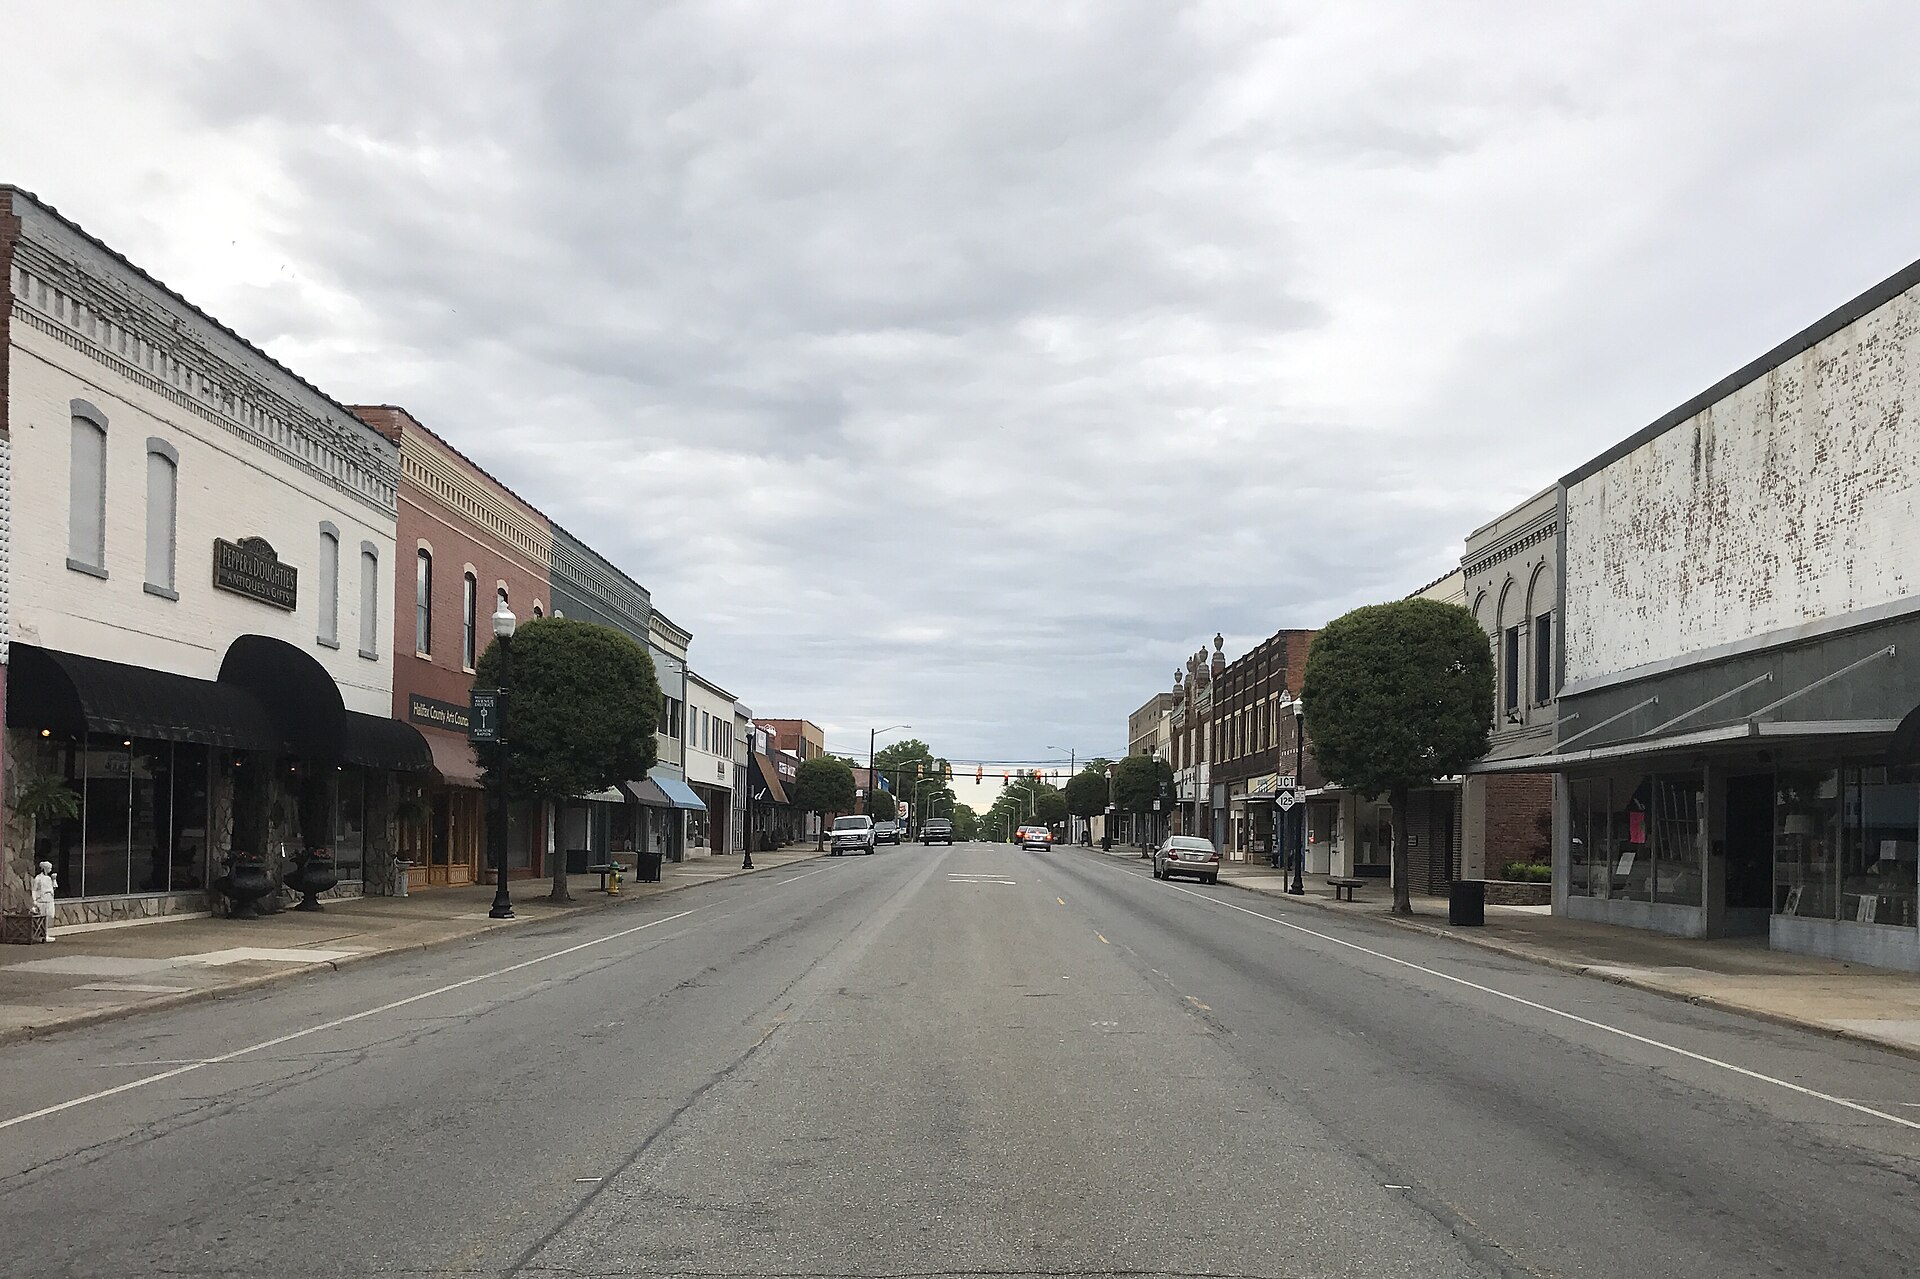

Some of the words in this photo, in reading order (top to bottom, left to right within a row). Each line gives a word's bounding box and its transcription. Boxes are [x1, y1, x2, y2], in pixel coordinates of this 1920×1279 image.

[223, 545, 248, 573] PEPPER
[227, 572, 266, 594] ANTIQUES
[271, 587, 290, 603] GIFTS
[413, 701, 430, 718] Halifax
[430, 705, 446, 724] County
[446, 710, 454, 723] Arts
[454, 712, 469, 727] Counci
[1277, 777, 1294, 787] JCT
[1280, 797, 1293, 805] 125
